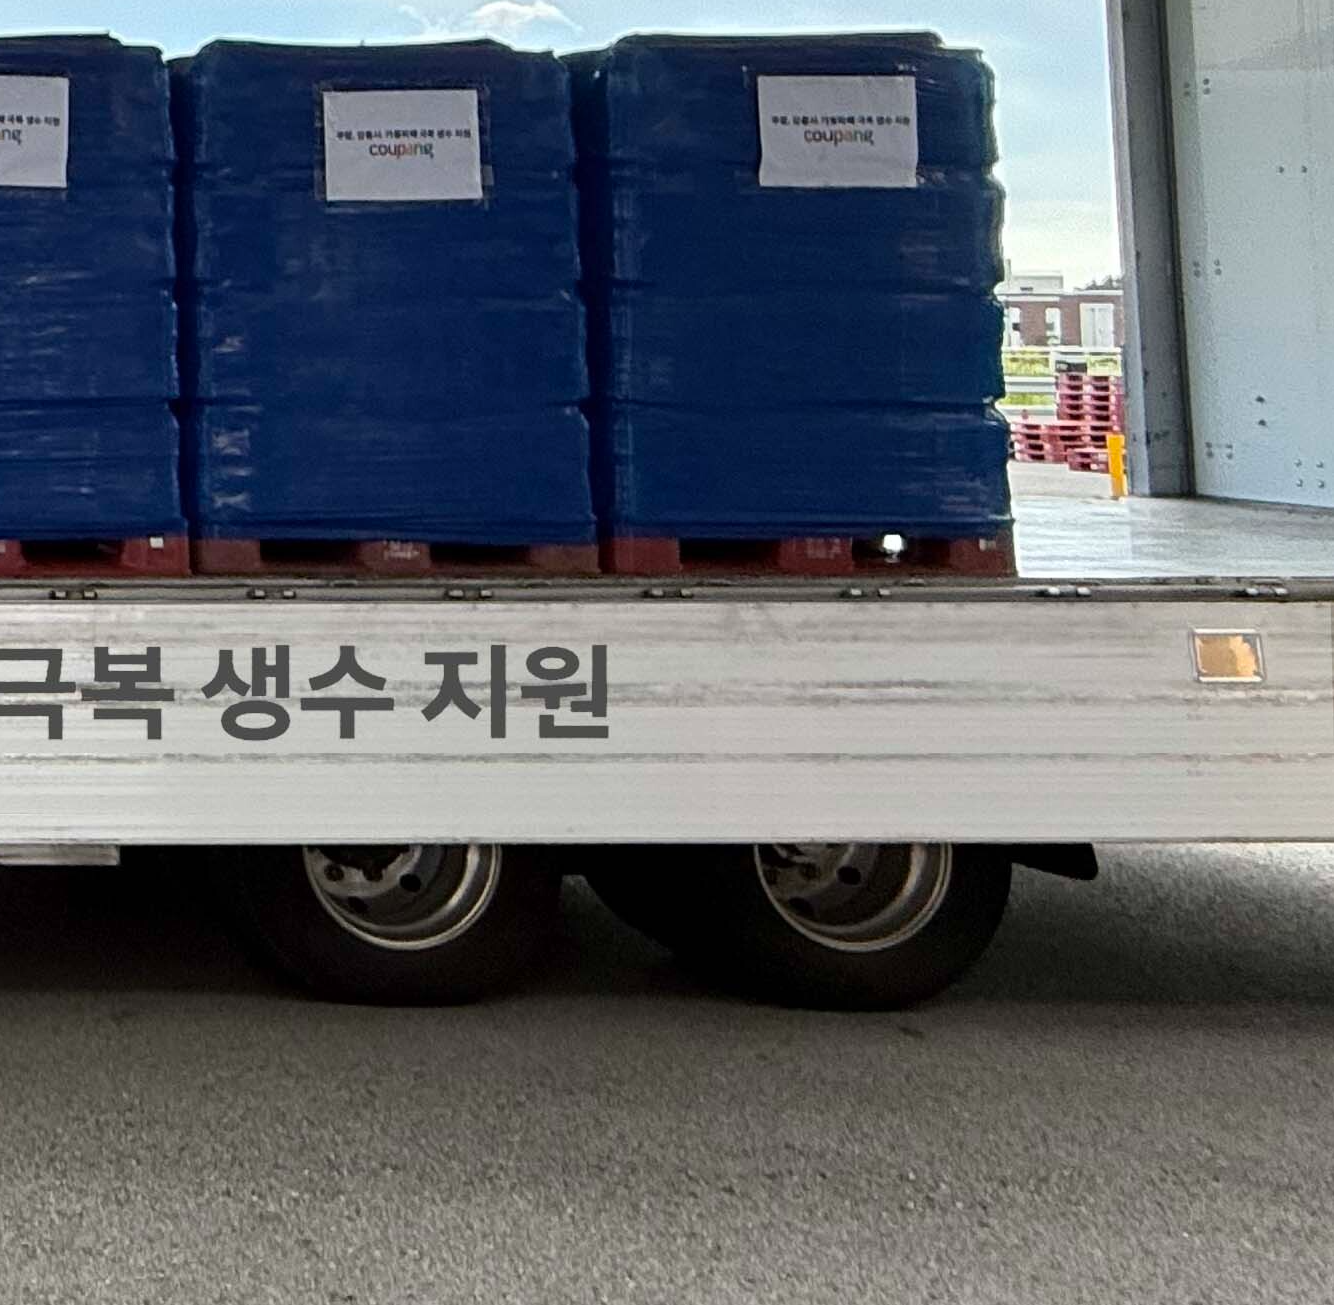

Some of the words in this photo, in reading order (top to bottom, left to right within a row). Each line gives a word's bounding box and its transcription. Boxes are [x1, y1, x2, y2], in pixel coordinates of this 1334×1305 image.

[804, 130, 874, 146] coupang
[369, 143, 434, 159] coupang
[201, 645, 395, 741] 생수
[421, 645, 610, 739] 지원
